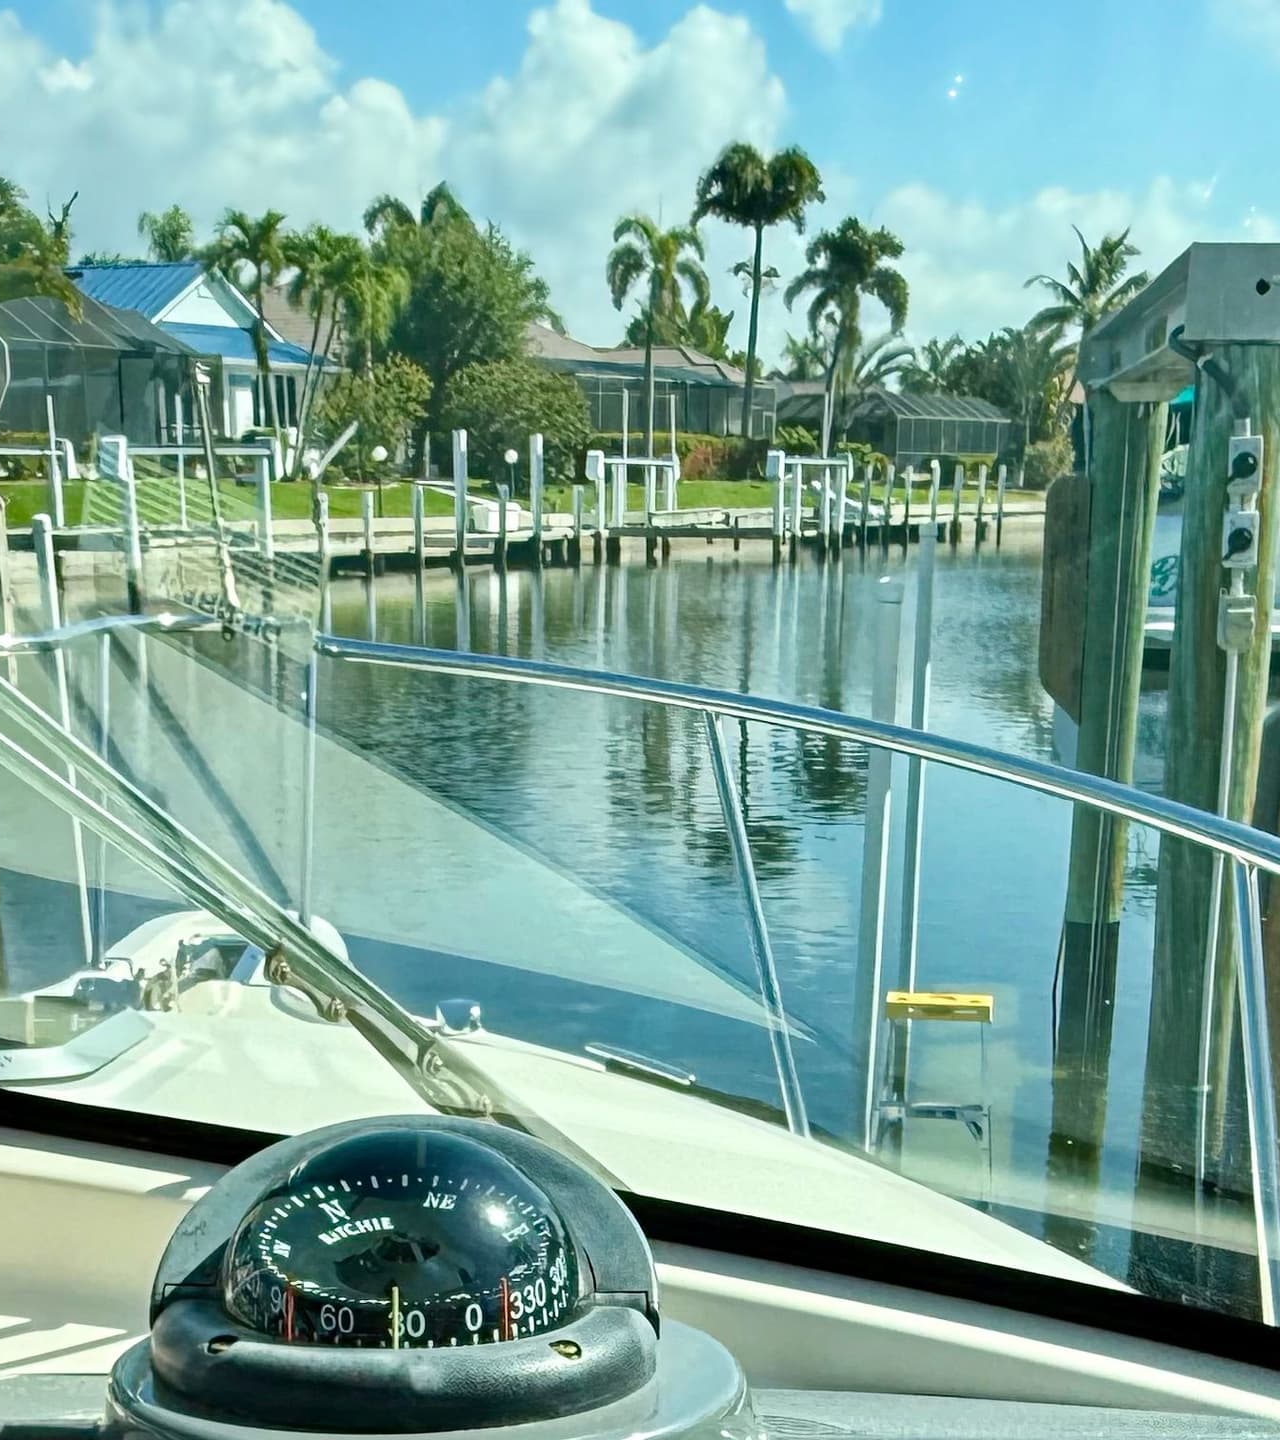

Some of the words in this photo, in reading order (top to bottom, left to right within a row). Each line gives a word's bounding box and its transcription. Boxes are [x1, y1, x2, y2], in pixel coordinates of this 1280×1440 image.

[318, 1199, 351, 1224] N
[423, 1191, 457, 1210] NE
[318, 1217, 394, 1245] RITCHIE
[509, 1278, 546, 1319] 330
[320, 1304, 354, 1333] 60
[465, 1303, 483, 1332] 0
